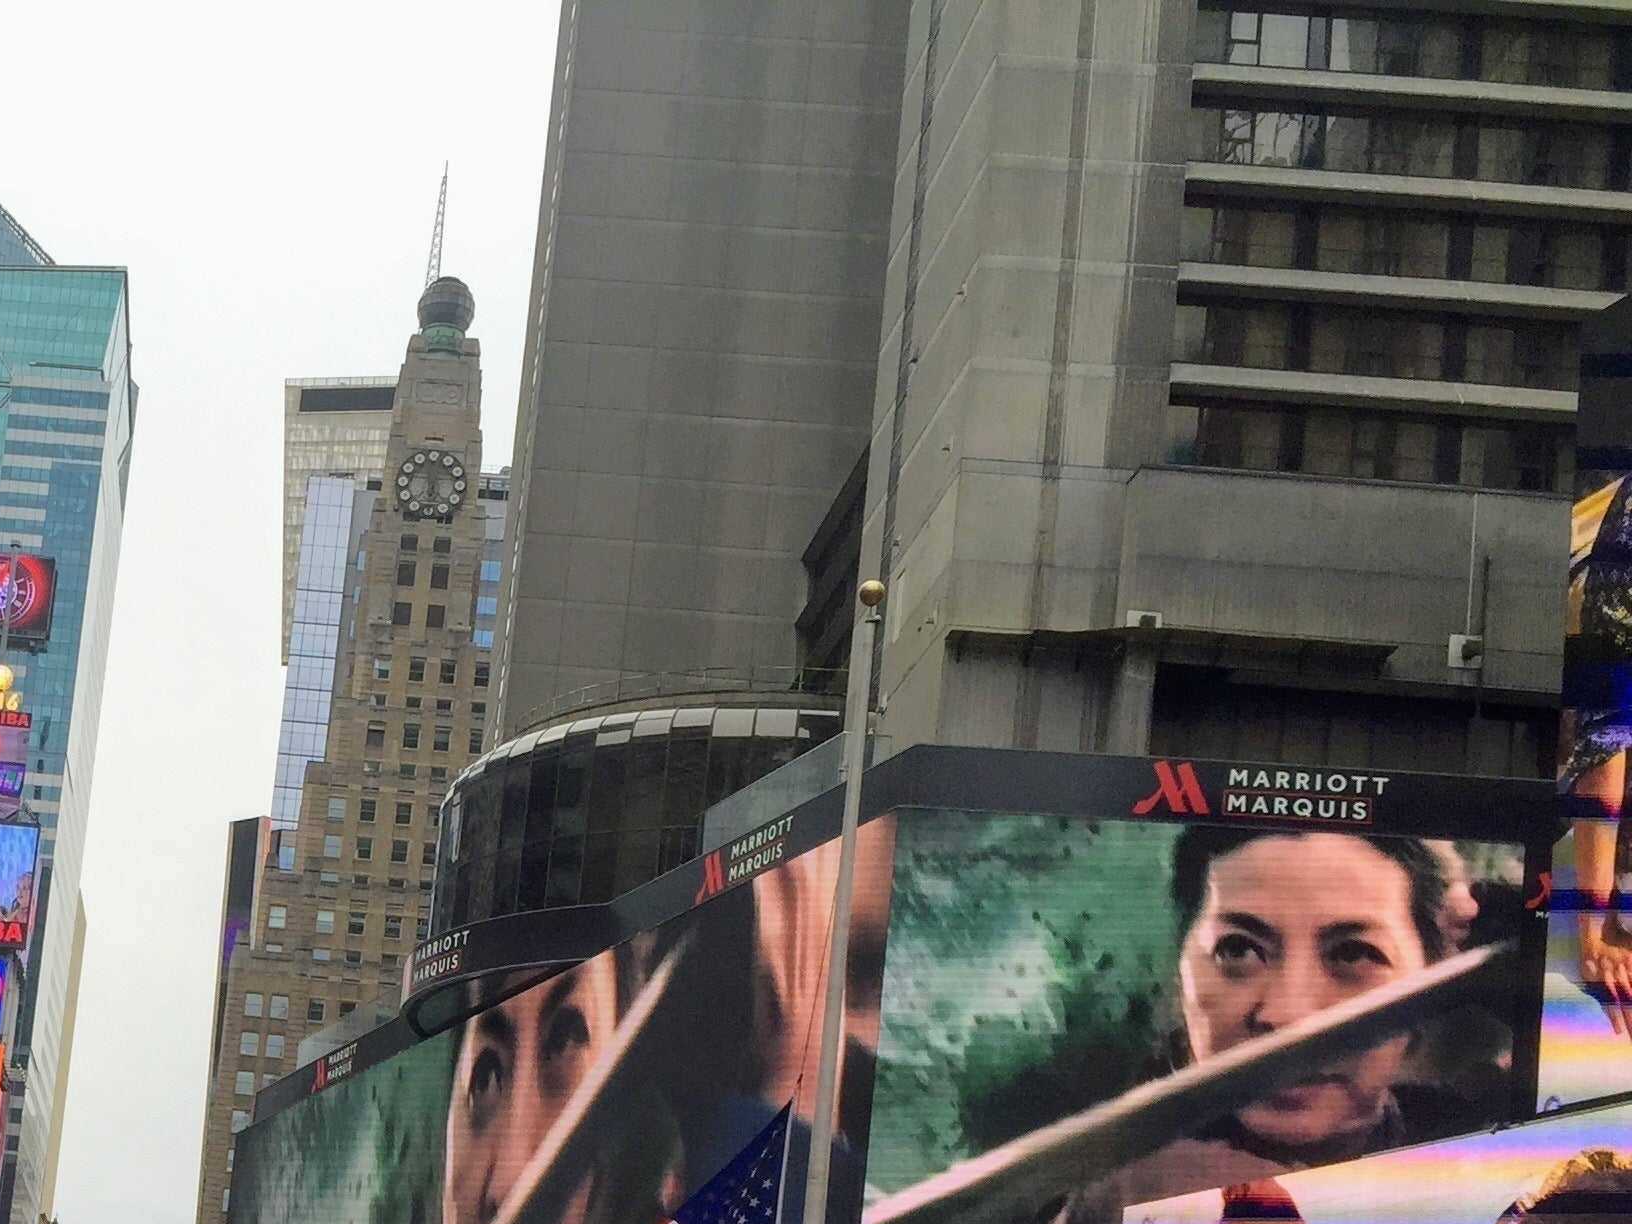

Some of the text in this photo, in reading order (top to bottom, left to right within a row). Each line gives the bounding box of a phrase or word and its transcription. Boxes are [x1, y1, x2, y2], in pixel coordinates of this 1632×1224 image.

[1228, 768, 1390, 795] MARRIOTT
[1227, 794, 1369, 820] MARQUIS
[730, 816, 793, 860] MARRIOTT
[728, 842, 784, 882] MARQUIS
[414, 930, 470, 965] MARRIOTT
[412, 953, 459, 983] MARQUIS
